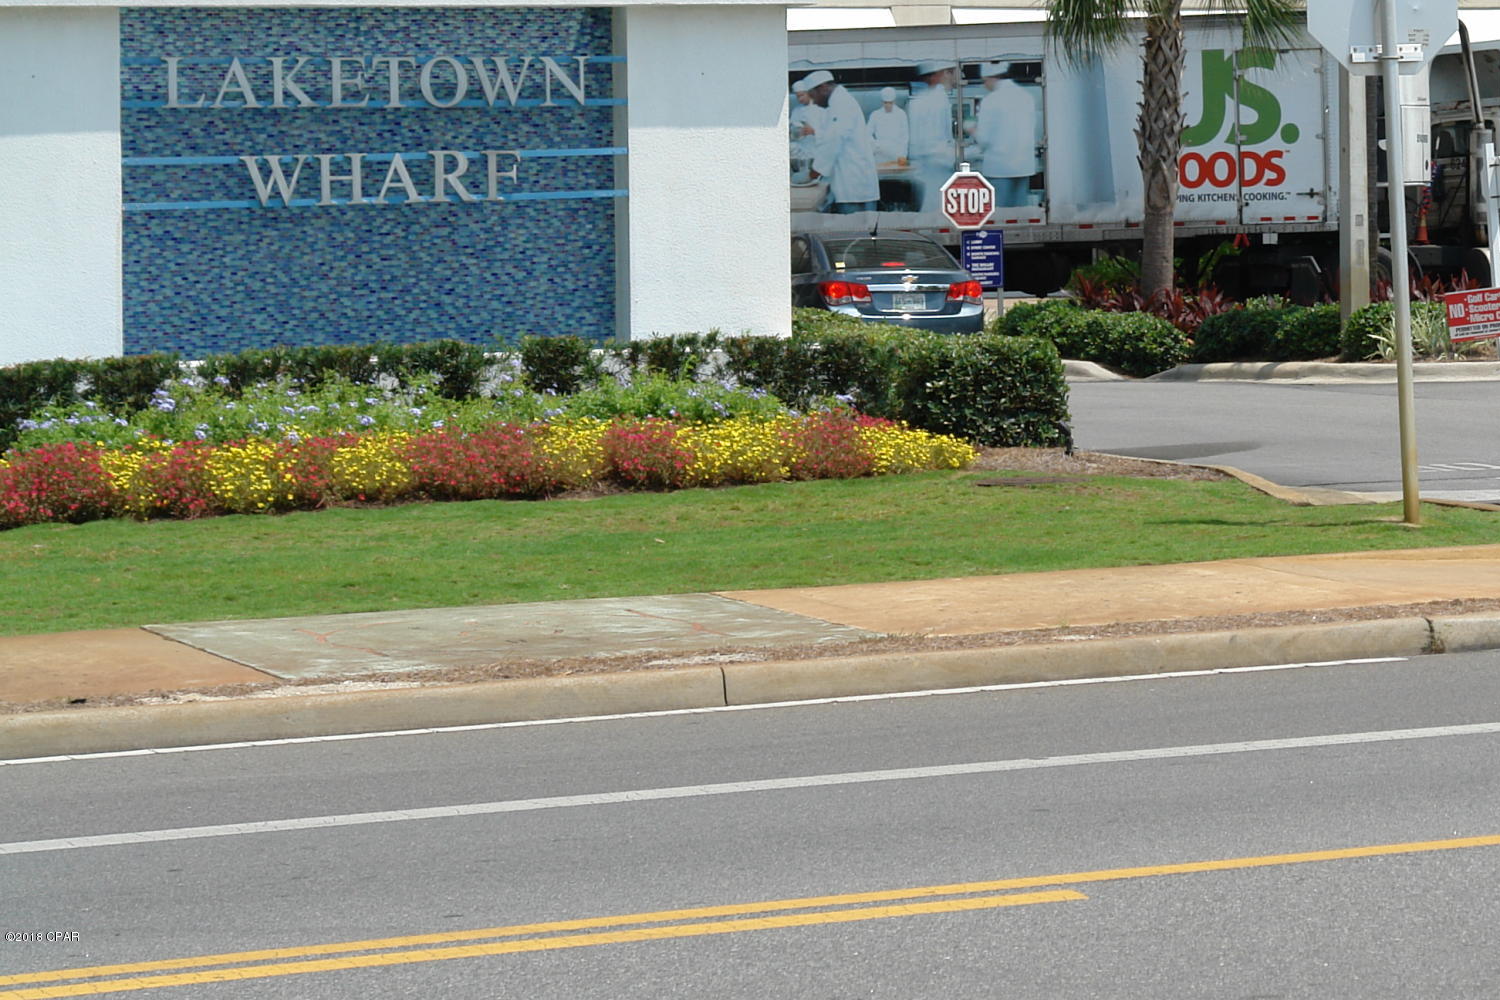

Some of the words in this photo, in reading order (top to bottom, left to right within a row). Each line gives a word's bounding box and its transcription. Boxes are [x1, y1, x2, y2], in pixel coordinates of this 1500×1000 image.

[160, 55, 591, 109] LAKETOWN
[239, 149, 522, 208] WHARF
[1178, 149, 1287, 189] OODS
[946, 187, 990, 214] STOP
[1197, 192, 1239, 203] KITCHEN
[1448, 303, 1465, 319] NO
